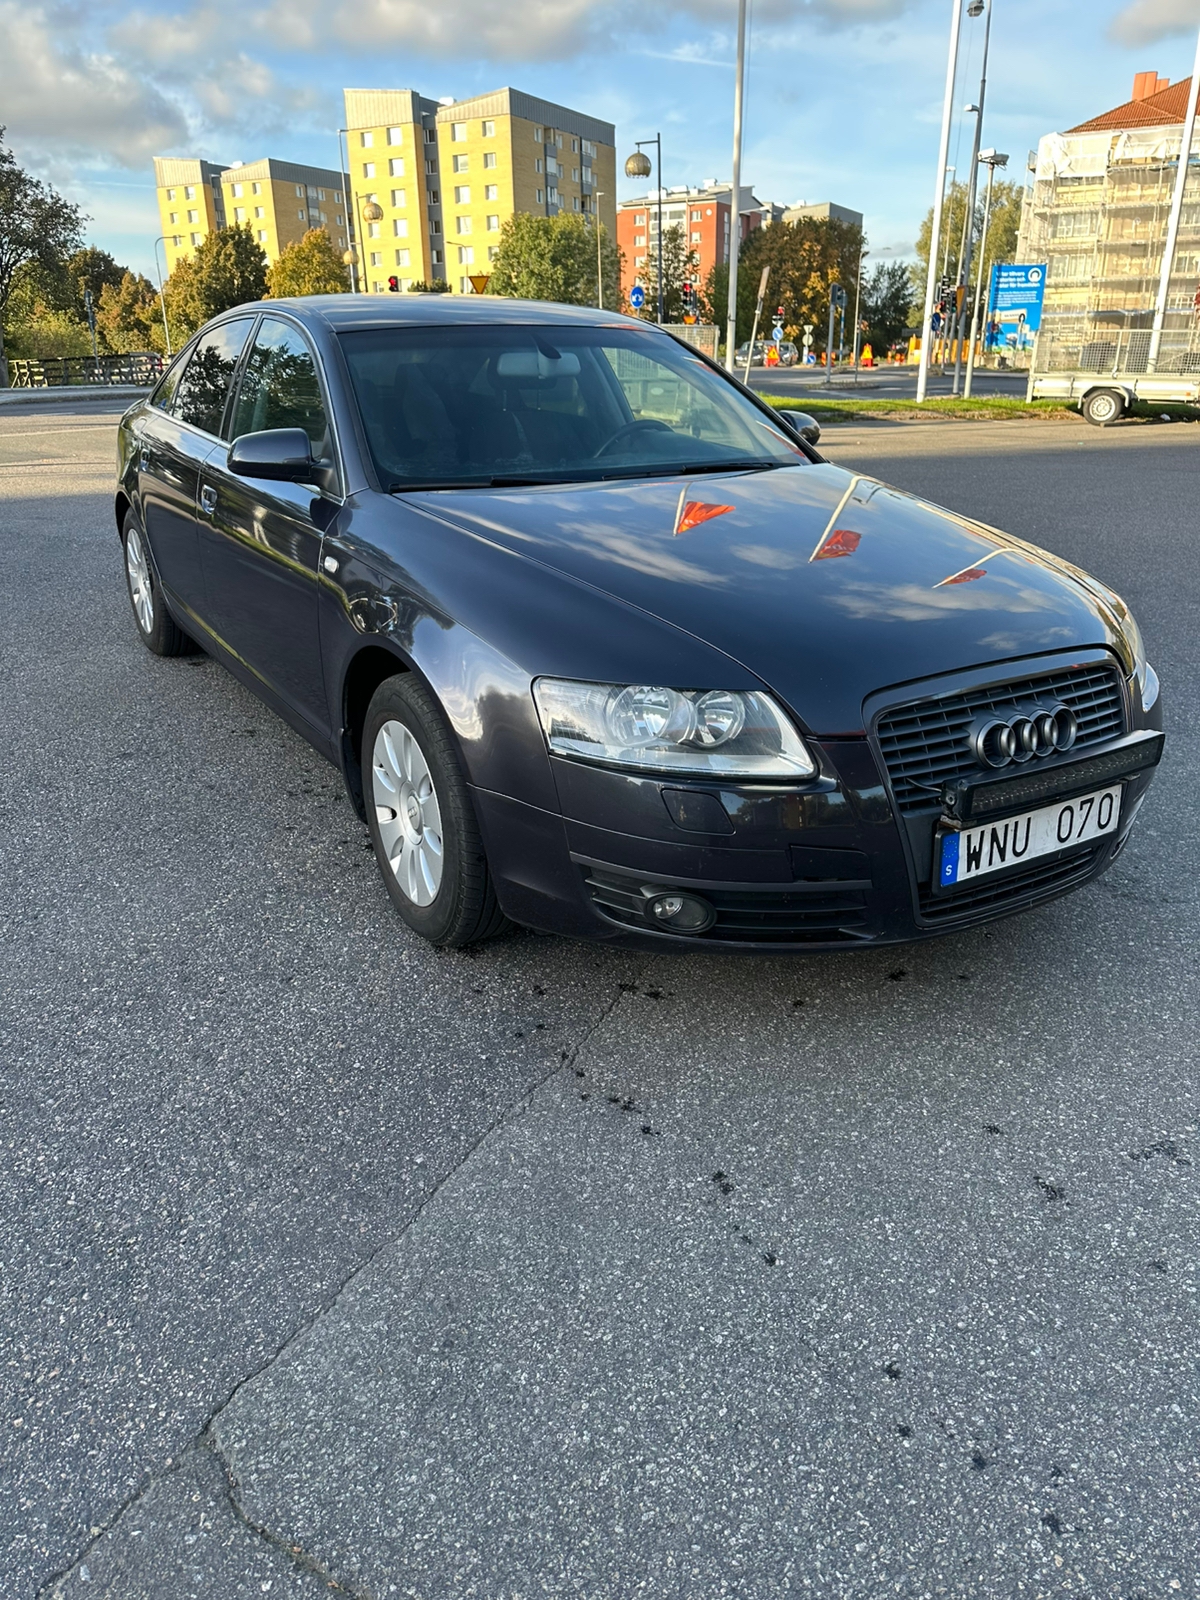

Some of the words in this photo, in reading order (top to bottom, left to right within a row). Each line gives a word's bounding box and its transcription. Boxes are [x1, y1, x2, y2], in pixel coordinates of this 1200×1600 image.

[966, 817, 1032, 873] WNU
[1056, 792, 1114, 844] 070
[945, 864, 953, 876] S
